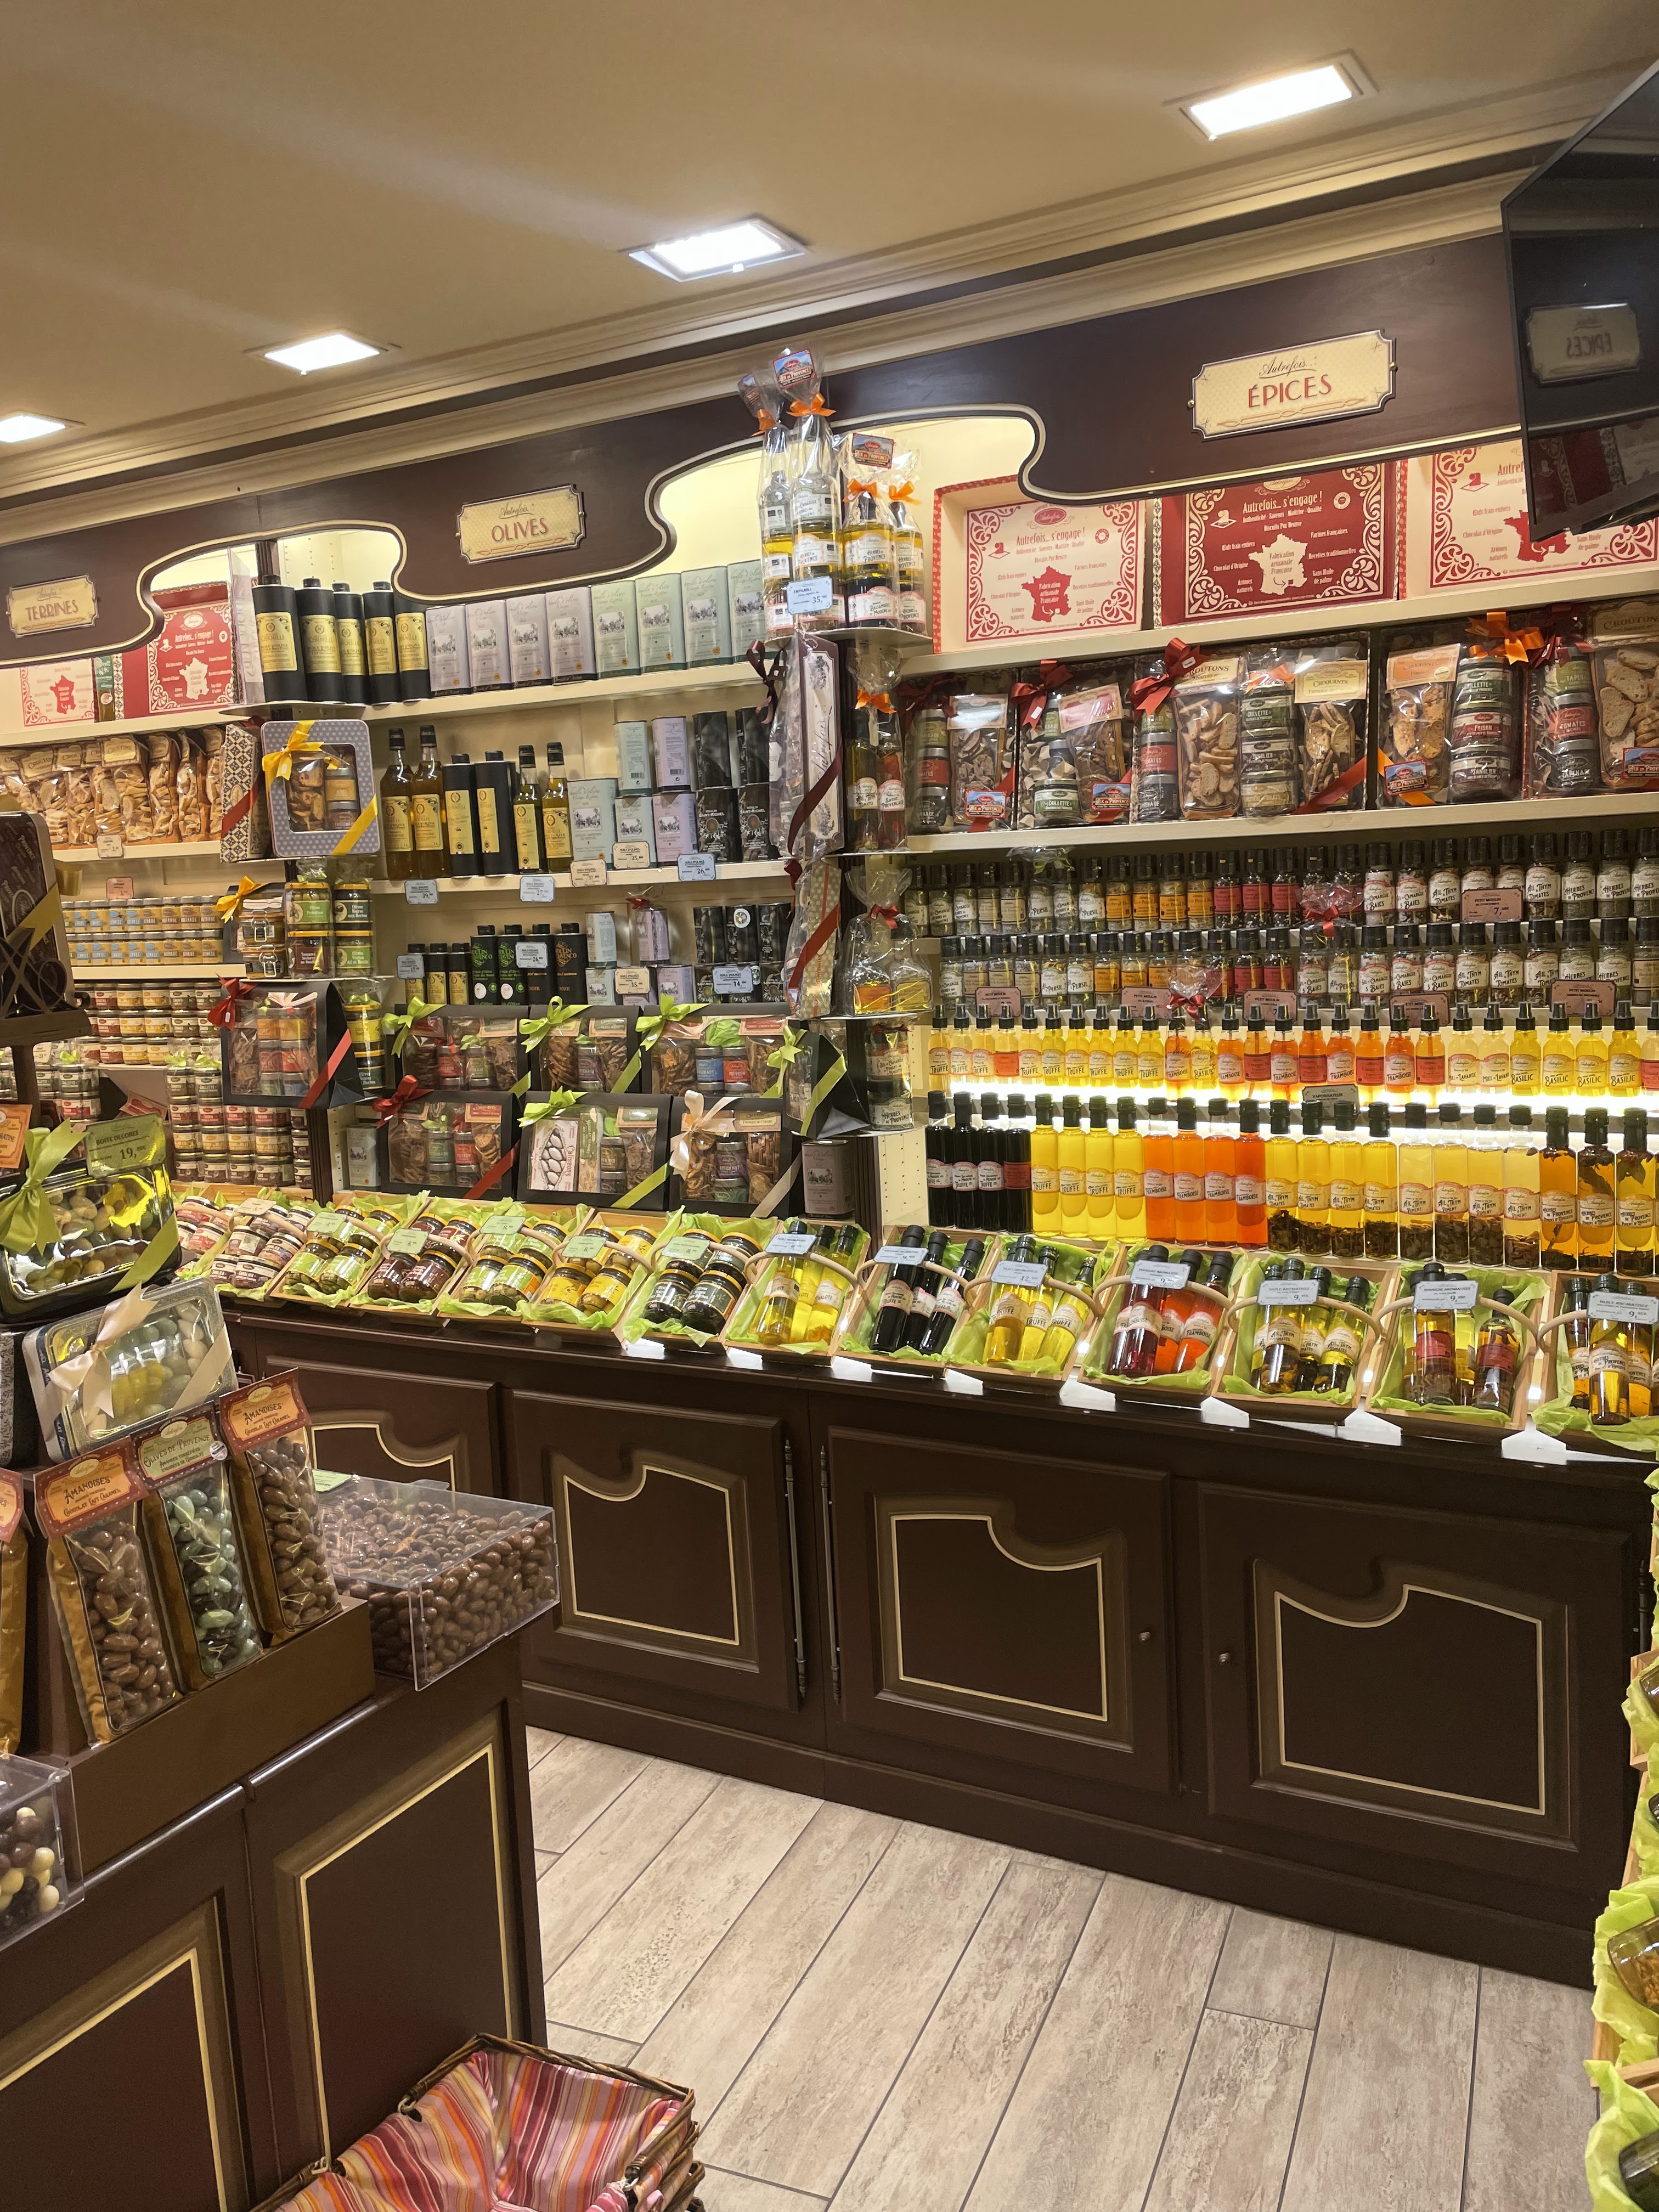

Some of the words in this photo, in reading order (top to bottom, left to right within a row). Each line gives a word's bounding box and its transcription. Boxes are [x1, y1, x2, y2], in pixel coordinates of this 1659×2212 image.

[1249, 374, 1331, 408] ÉPICES
[492, 518, 548, 541] OLIVES
[26, 600, 78, 621] TERRINES
[1565, 885, 1585, 894] HERBES
[1603, 883, 1623, 893] HERBES
[1634, 883, 1654, 892] HERBES
[1432, 890, 1442, 898] AIL
[1444, 888, 1457, 896] THYM
[1529, 891, 1549, 900] TOMATES
[1404, 900, 1420, 910] BAIES
[1434, 895, 1455, 905] TOMATES
[1369, 901, 1385, 911] BAIES
[1033, 907, 1048, 916] PERSIL
[1457, 972, 1466, 981] AIL
[1493, 970, 1503, 980] AIL
[1503, 968, 1520, 978] THYM
[1534, 970, 1546, 980] AIL
[1565, 972, 1585, 980] HERBES
[1599, 971, 1618, 980] HERBES
[1073, 982, 1087, 991] PERSIL
[1397, 980, 1412, 990] BAIES
[1432, 981, 1448, 991] BAIES
[1459, 978, 1480, 987] TOMATES
[1495, 977, 1517, 988] TOMATES
[1048, 984, 1063, 993] PERSIL
[1307, 985, 1322, 995] BAIES
[1370, 984, 1385, 993] BAIES
[930, 1065, 949, 1073] TRUFFE
[951, 1065, 967, 1074] TRUFFE
[1020, 1068, 1039, 1076] TRUFFE
[1043, 1066, 1060, 1075] TRUFFE
[1067, 1066, 1085, 1076] TRUFFE
[1090, 1068, 1107, 1076] TRUFFE
[1115, 1068, 1134, 1077] TRUFFE
[1139, 1069, 1158, 1079] TRUFFE
[1166, 1069, 1188, 1077] FRAMBOISE
[1273, 1071, 1296, 1081] FRAMBOISE
[1331, 1069, 1354, 1080] FRAMBOISE
[1387, 1071, 1412, 1082] FRAMBOISE
[1511, 1074, 1533, 1085] BASILIC
[1545, 1074, 1568, 1087] BASILIC
[1578, 1076, 1601, 1087] BASILIC
[1611, 1074, 1635, 1086] BASILIC
[883, 1111, 900, 1119] HERBES
[1032, 1182, 1052, 1191] TRUFFE
[1060, 1184, 1080, 1194] TRUFFE
[1088, 1186, 1108, 1195] TRUFFE
[1116, 1186, 1136, 1196] TRUFFE
[1146, 1186, 1167, 1195] FRAMBOISE
[1177, 1190, 1199, 1199] FRAMBOISE
[1207, 1189, 1229, 1198] FRAMBOISE
[1236, 1193, 1258, 1201] FRAMBOISE
[1186, 1329, 1211, 1338] FRAMBOISE
[1337, 1341, 1352, 1350] THYM
[243, 1403, 282, 1425] AMANDISES
[245, 1425, 263, 1436] CHOCOLAT
[143, 1448, 168, 1468] OLIVES
[168, 1444, 177, 1453] DE
[177, 1434, 210, 1451] PROVENCE
[63, 1476, 110, 1504] AMANDISES
[64, 1502, 87, 1517] CHOCOLAT
